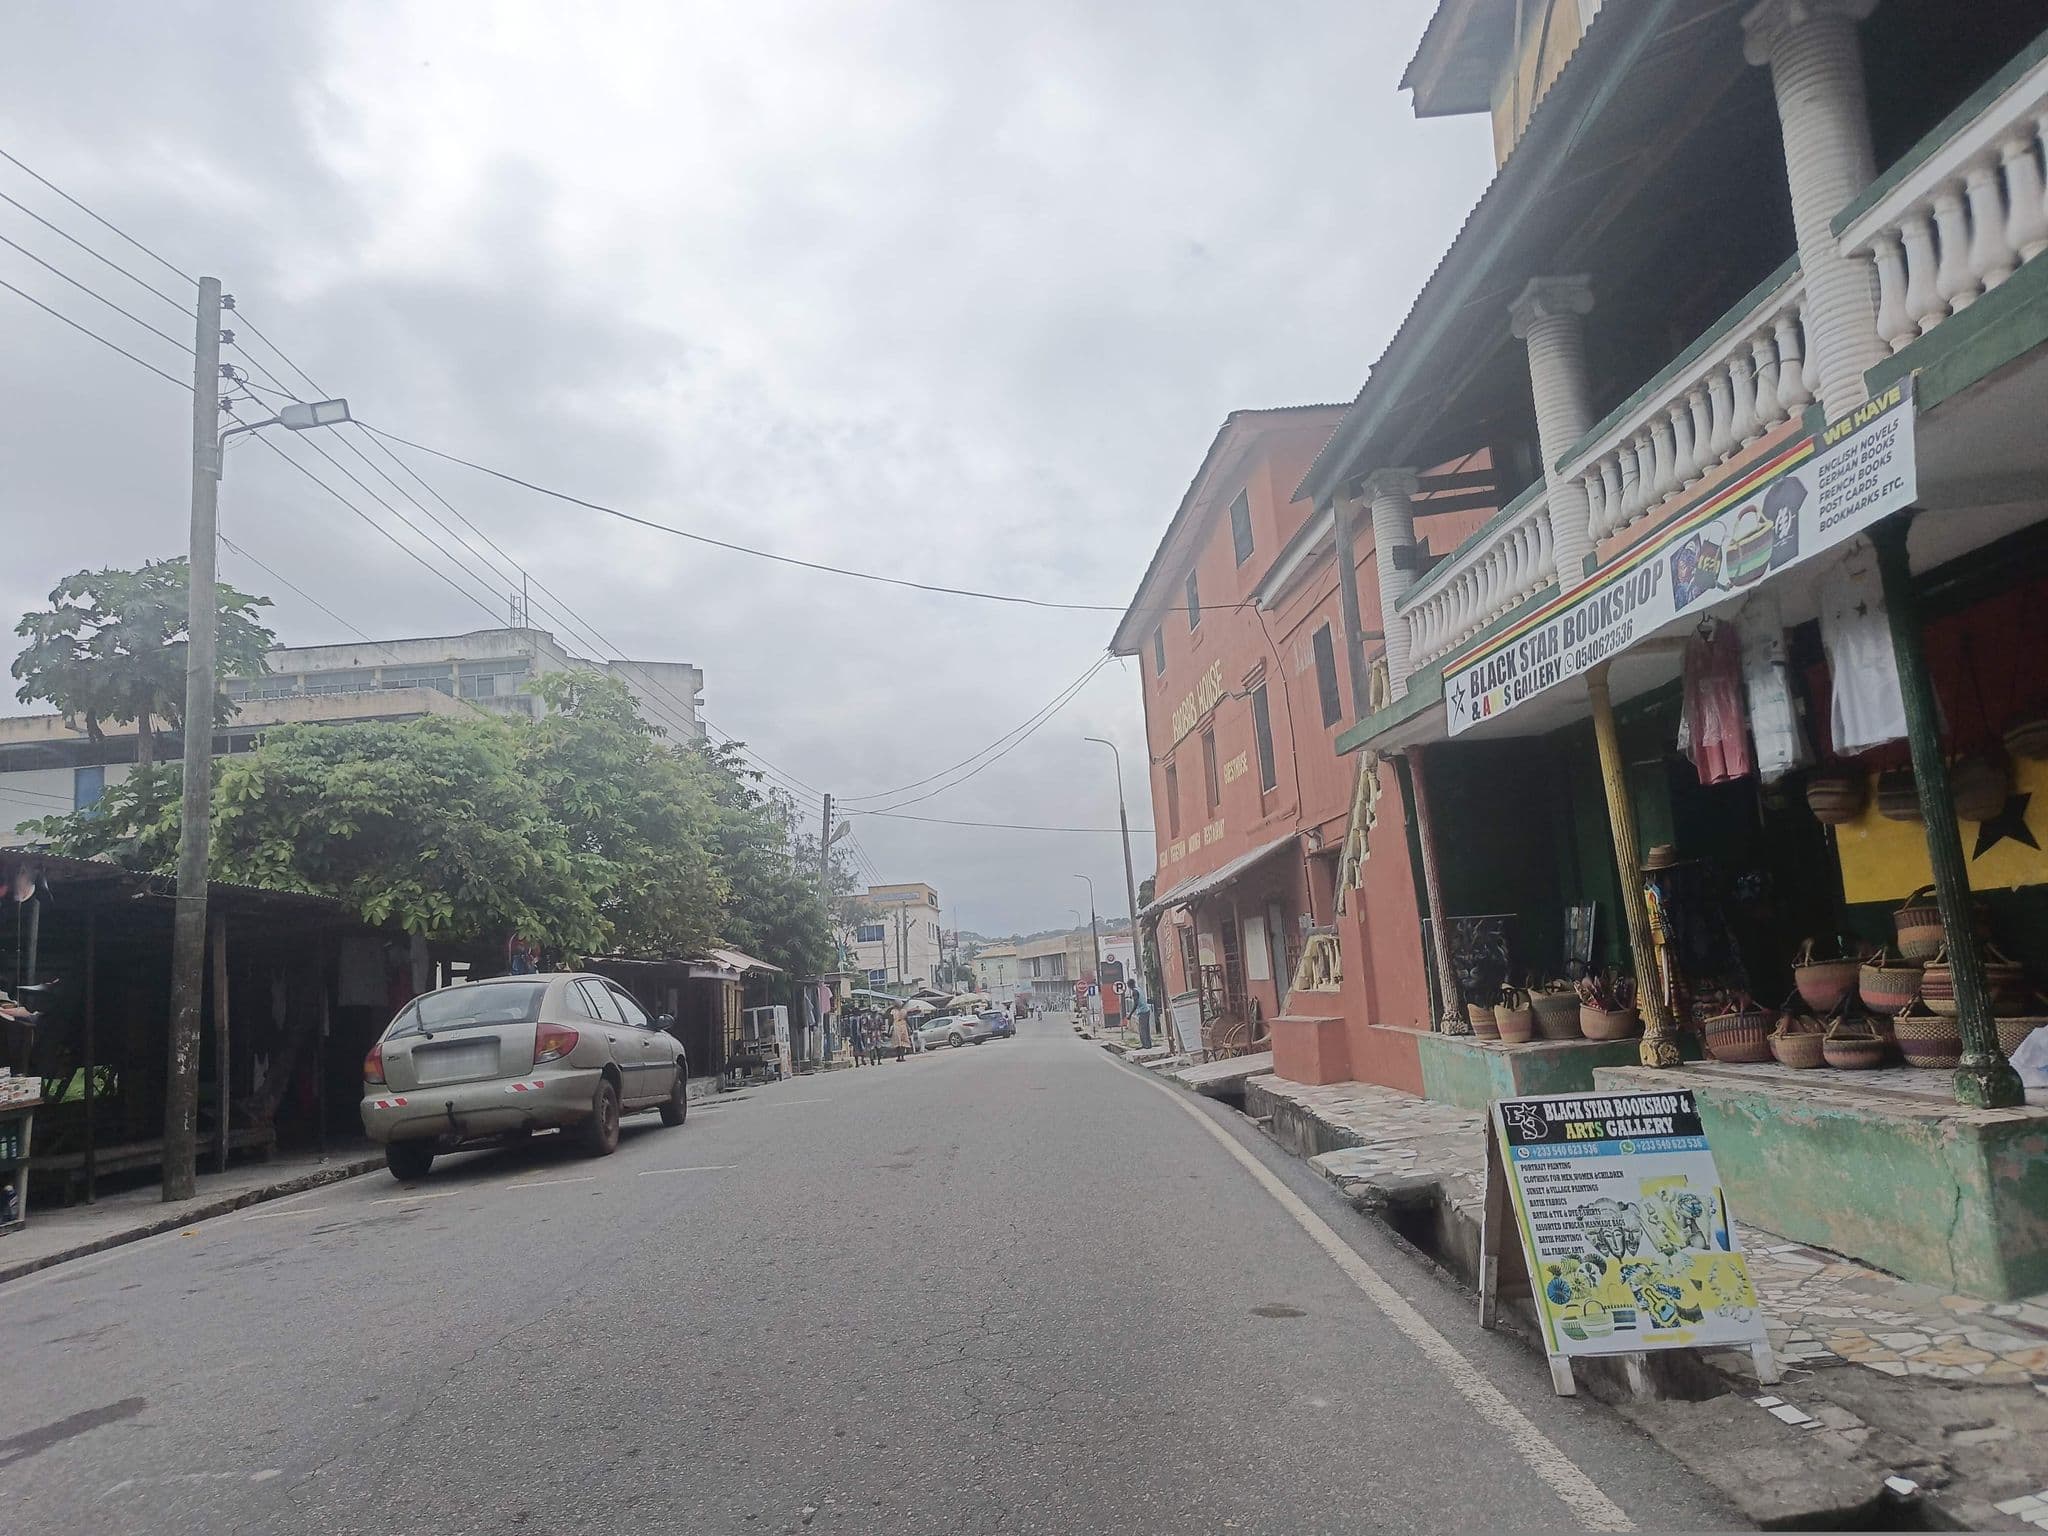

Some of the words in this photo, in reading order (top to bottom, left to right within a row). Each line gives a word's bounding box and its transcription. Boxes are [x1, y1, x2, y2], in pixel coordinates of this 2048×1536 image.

[1823, 417, 1852, 445] WE
[1854, 386, 1901, 427] HAVE
[1819, 445, 1858, 477] ENGLISH
[1860, 418, 1899, 449] NOVELS
[1819, 458, 1859, 489] GERMAN
[1861, 434, 1895, 464] BOOKS
[1819, 475, 1855, 504] FRENCH
[1858, 451, 1892, 482] BOOKS
[1819, 496, 1843, 518] POST
[1845, 474, 1878, 501] CARDS
[1819, 489, 1880, 532] BOOKMARKS
[1881, 477, 1904, 497] ETC.
[1470, 647, 1518, 699] BLACK
[1519, 623, 1559, 673] STAR
[1563, 558, 1664, 650] BOOKSHOP
[1472, 701, 1481, 721] &
[1514, 657, 1561, 702] GALLERY
[1575, 618, 1633, 670] 0540623536
[1117, 983, 1123, 992] P
[1542, 1103, 1585, 1121] BLACK
[1585, 1100, 1615, 1119] STAR
[1615, 1095, 1678, 1117] BOOKSHOP
[1680, 1095, 1691, 1113] &
[1565, 1121, 1604, 1139] ARTS
[1605, 1117, 1674, 1136] GALLERY
[1550, 1174, 1560, 1182] FOR
